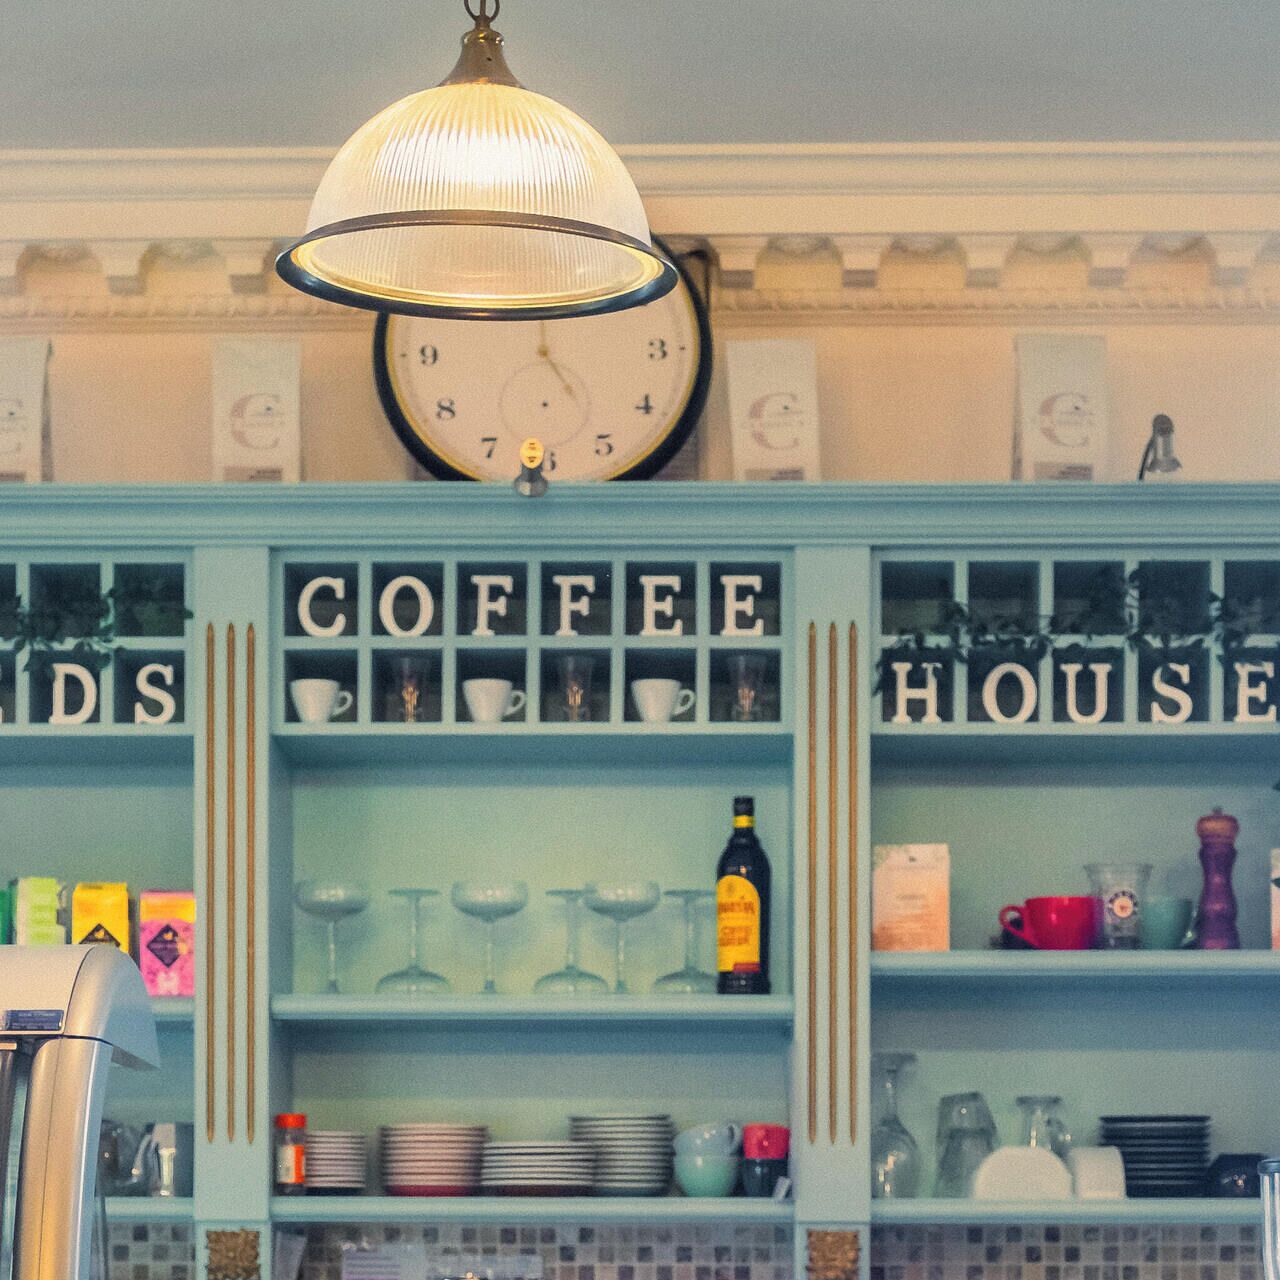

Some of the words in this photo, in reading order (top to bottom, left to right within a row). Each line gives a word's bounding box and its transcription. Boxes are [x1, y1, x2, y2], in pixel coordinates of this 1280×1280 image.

[419, 343, 440, 366] 9
[647, 338, 668, 361] 3
[435, 398, 457, 422] 8
[634, 393, 655, 416] 4
[480, 436, 500, 460] 7
[593, 433, 615, 458] 5
[296, 574, 765, 639] COFFEE
[891, 661, 1278, 725] HOUSE
